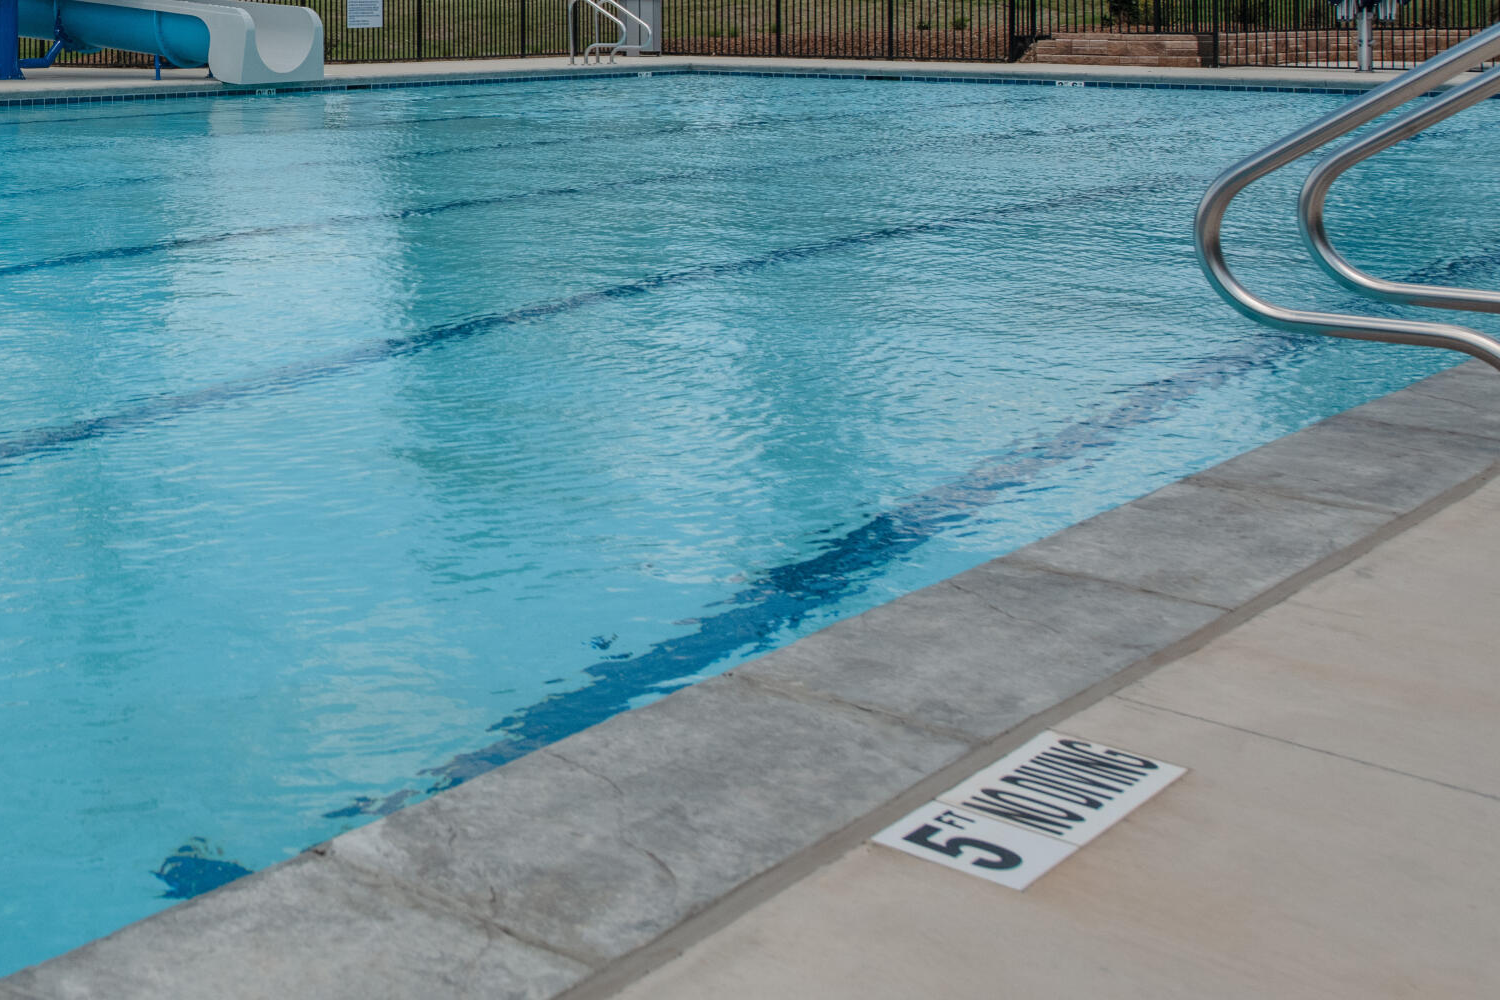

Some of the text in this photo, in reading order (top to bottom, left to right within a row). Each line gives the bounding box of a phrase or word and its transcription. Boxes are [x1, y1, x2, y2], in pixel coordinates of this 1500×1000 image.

[902, 739, 1160, 871] 5 FT NO DIVING
